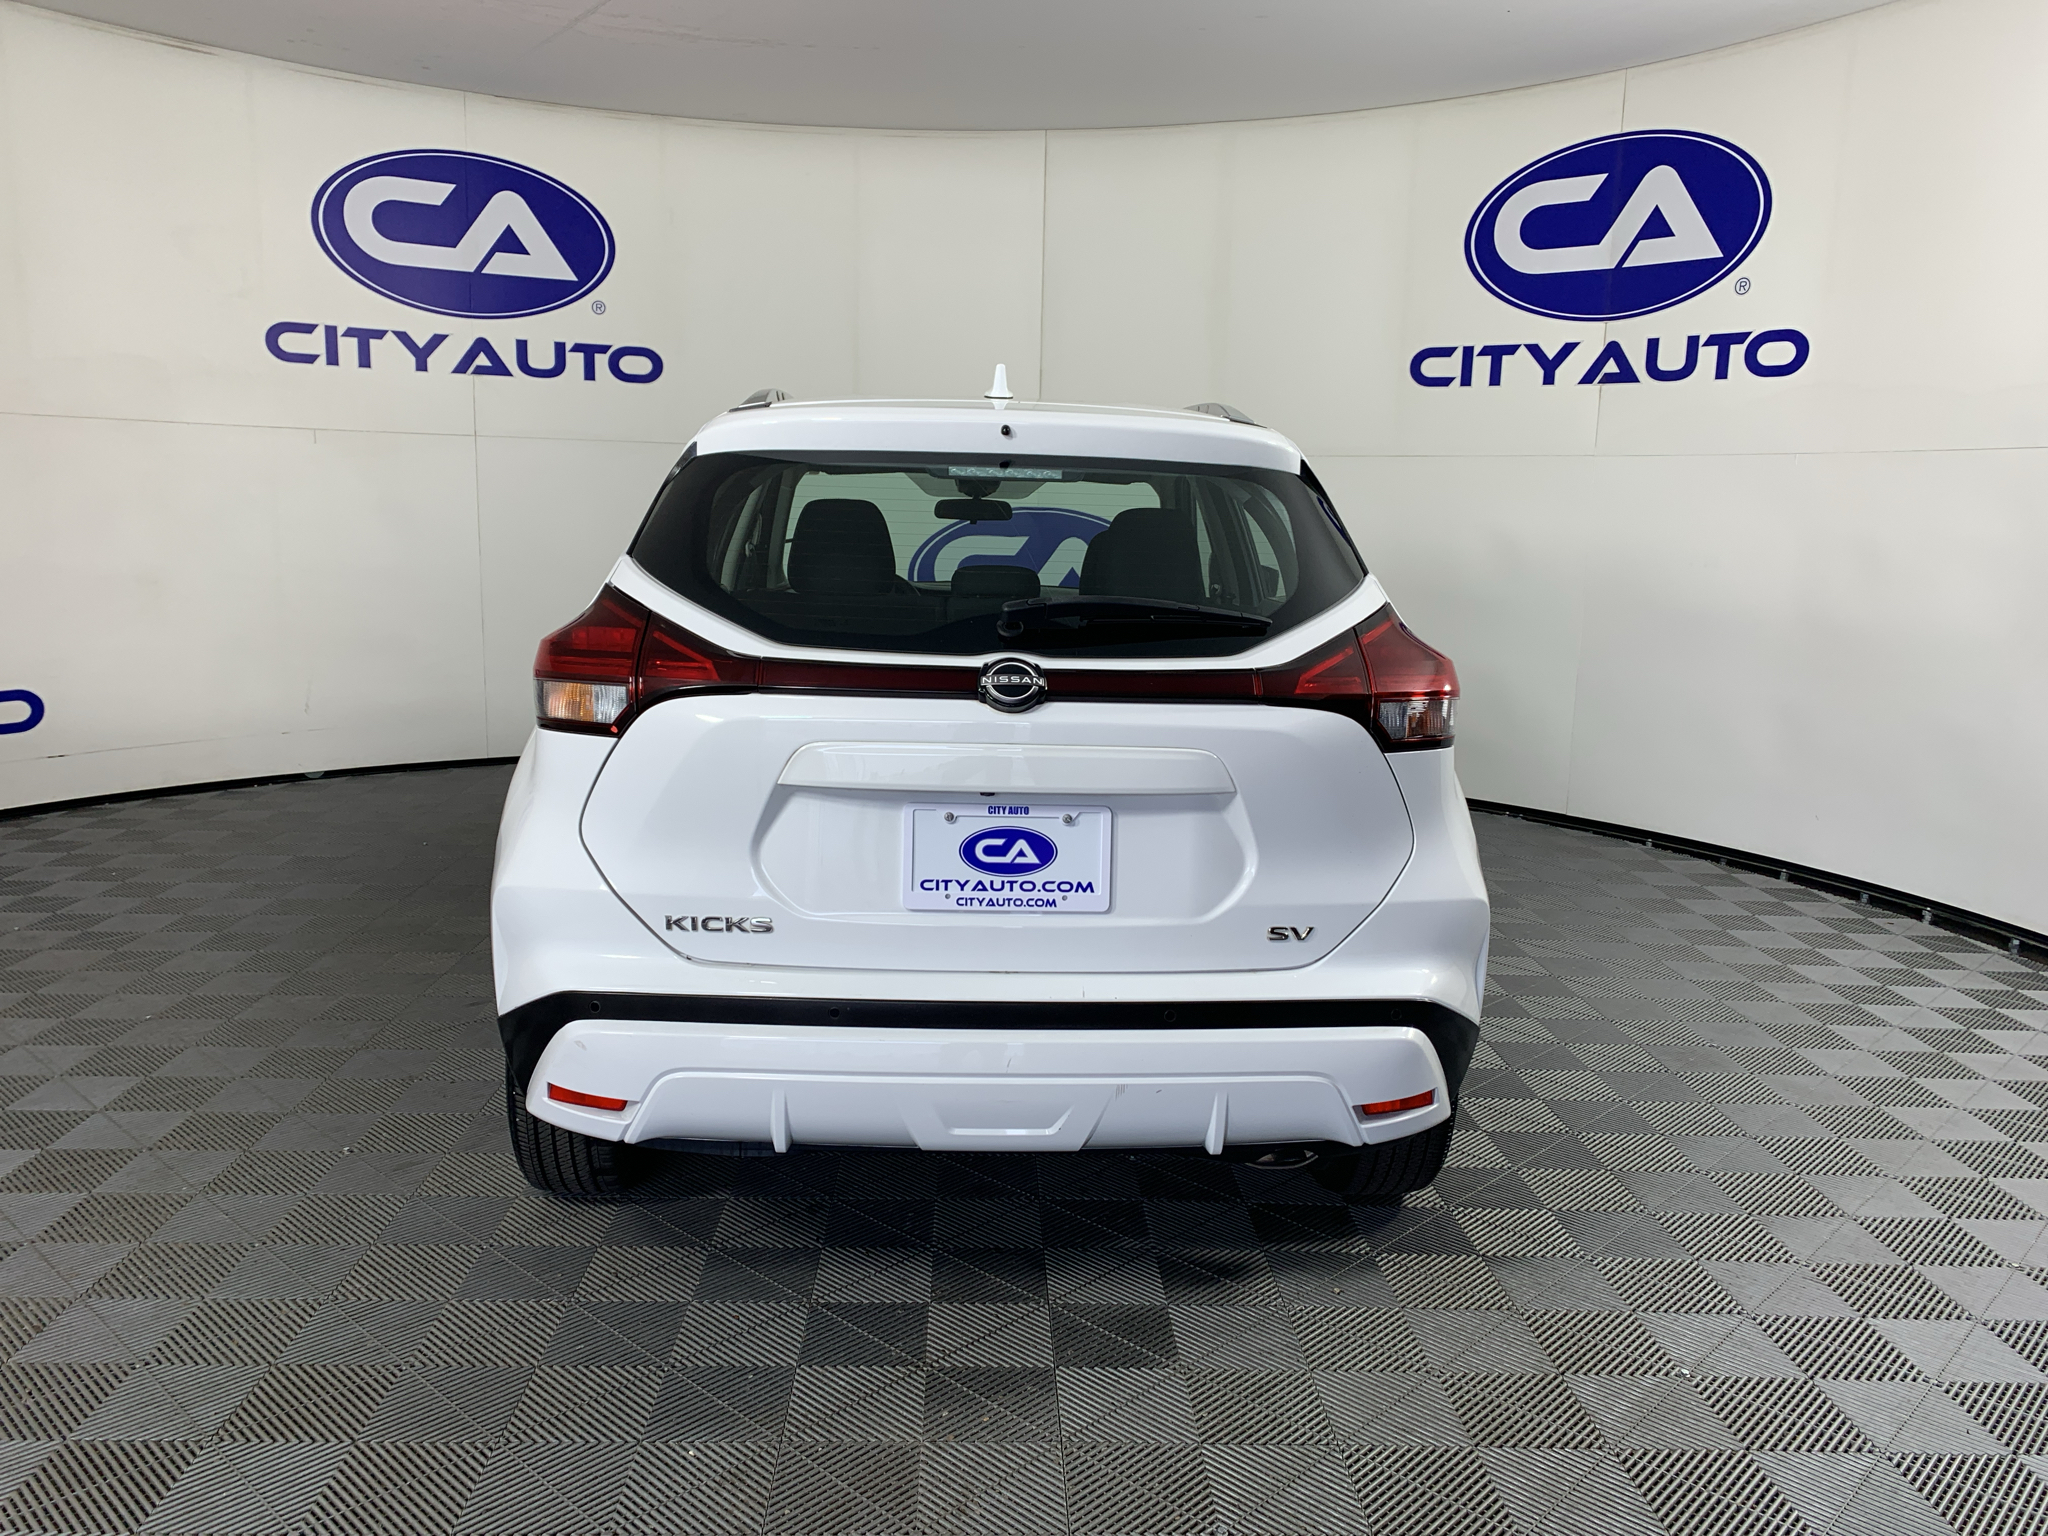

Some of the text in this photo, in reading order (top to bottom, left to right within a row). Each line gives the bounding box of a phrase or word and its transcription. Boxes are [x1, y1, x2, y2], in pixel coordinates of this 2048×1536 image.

[1494, 164, 1724, 275] CA
[343, 176, 578, 281] CA
[982, 675, 1042, 685] NISSAN
[987, 805, 1030, 816] CITY AUTO
[975, 838, 1042, 864] CA
[920, 879, 1095, 893] CITYAUTO.COM
[956, 897, 1057, 908] CITYAUTO.COM
[664, 915, 774, 933] KICKS
[1267, 926, 1315, 941] SV
